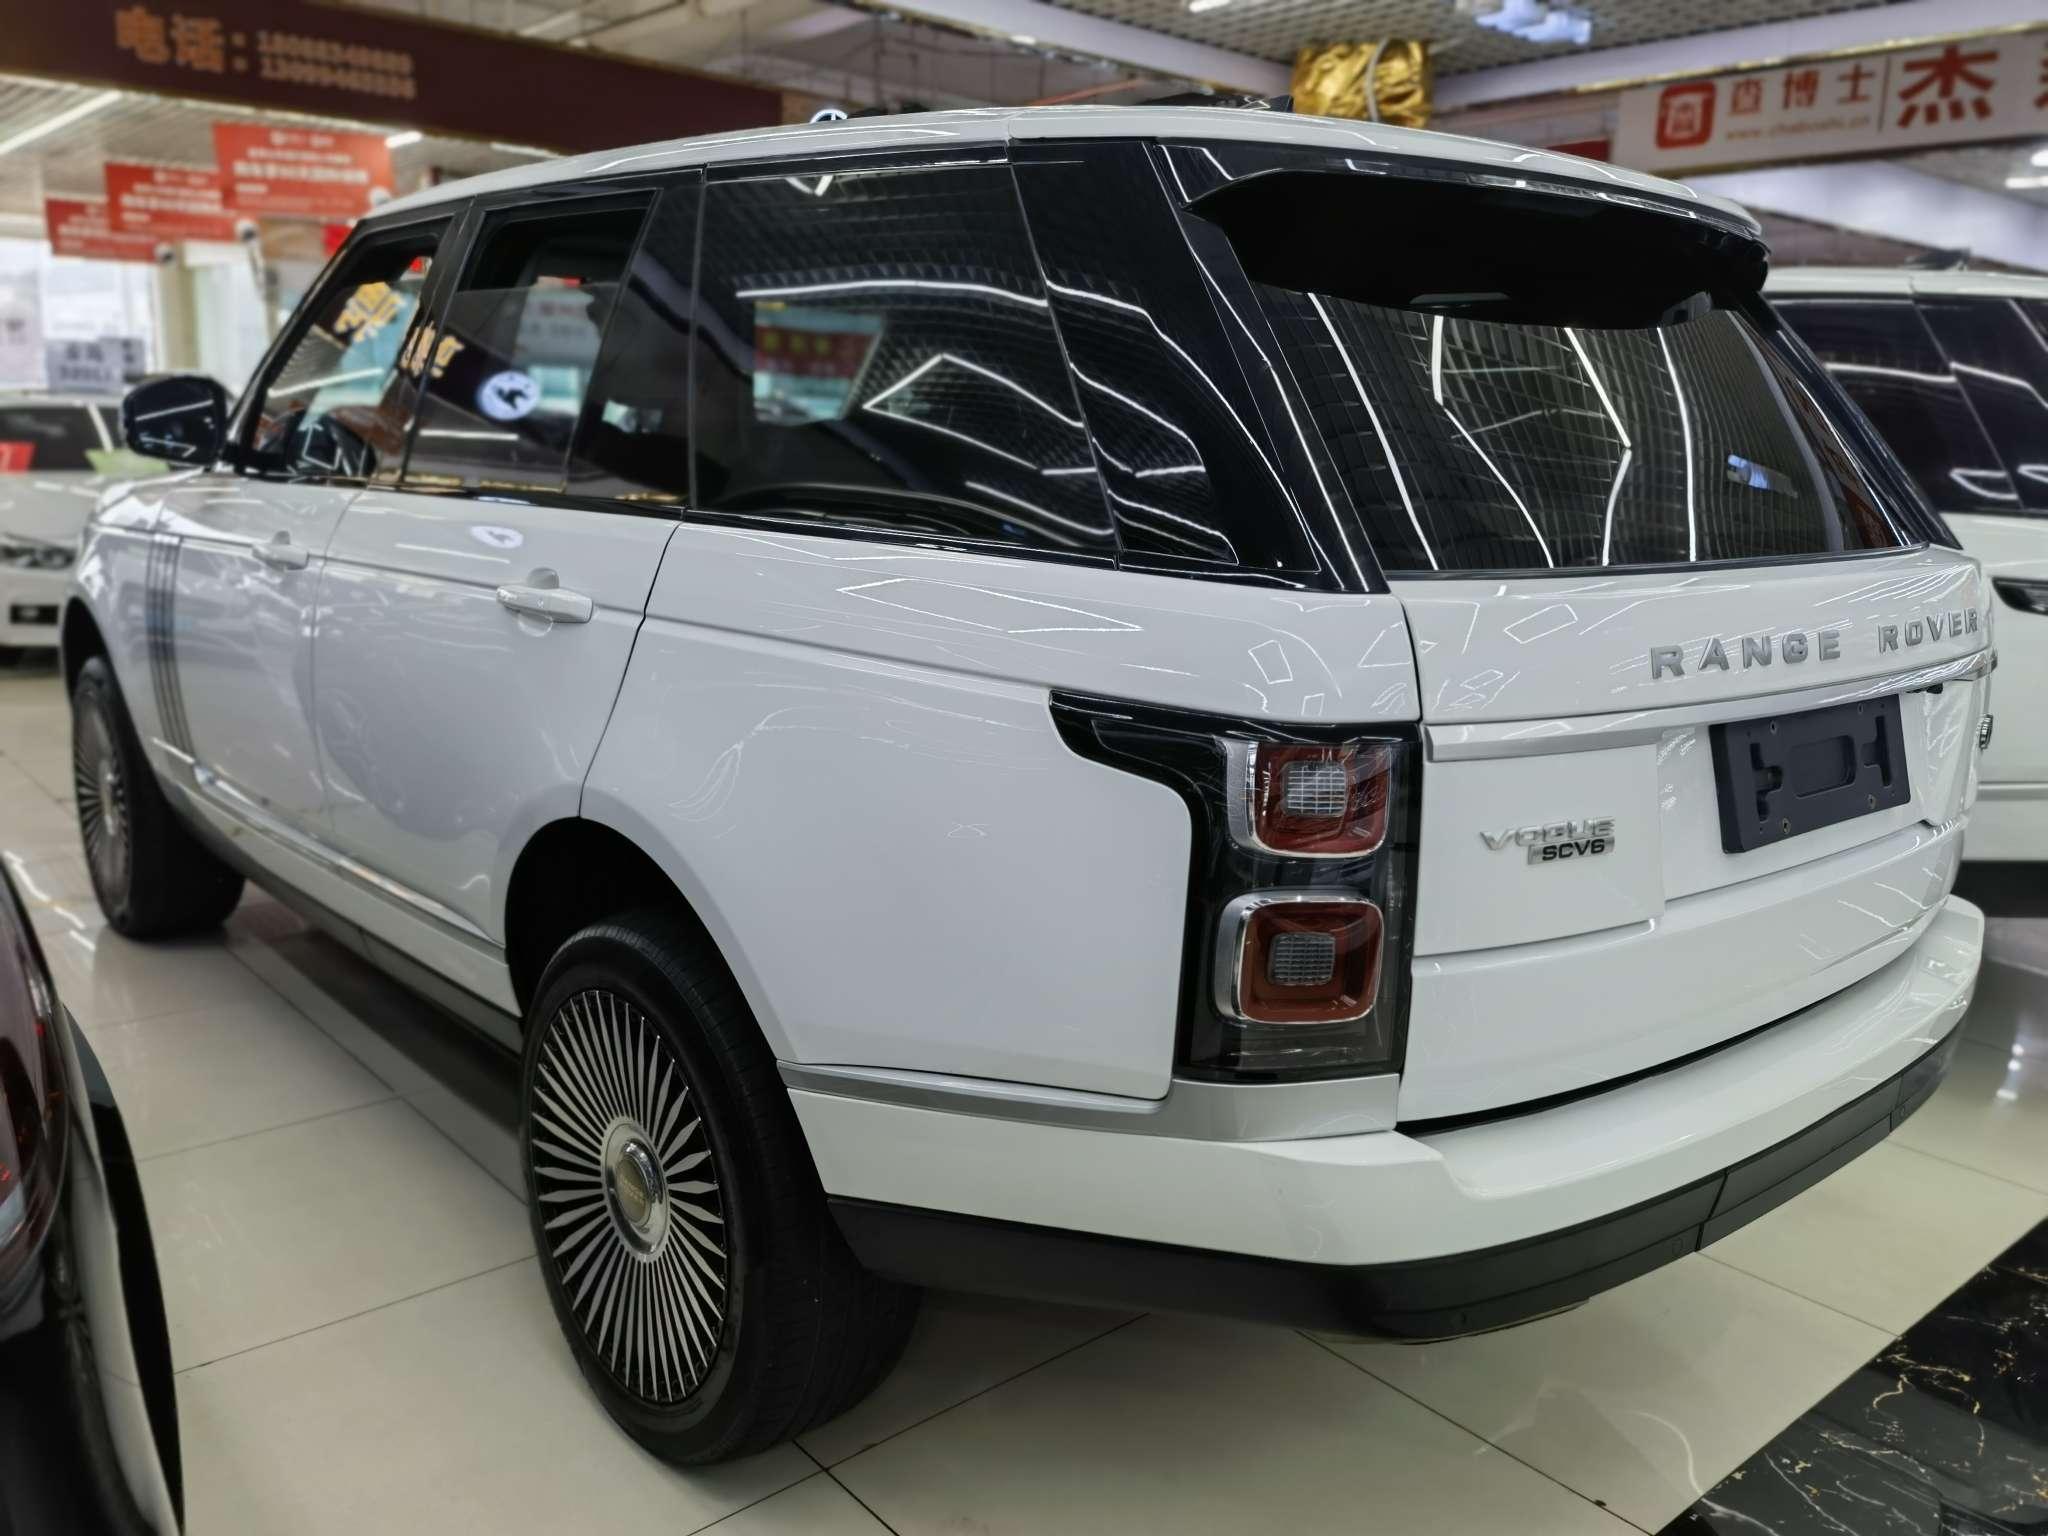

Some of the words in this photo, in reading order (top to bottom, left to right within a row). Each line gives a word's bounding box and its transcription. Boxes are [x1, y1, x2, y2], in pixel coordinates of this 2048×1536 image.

[1898, 43, 2048, 129] 杰
[1650, 629, 1841, 680] RANGE
[1877, 606, 1979, 654] ROVER
[1479, 815, 1616, 851] VOGUE
[1541, 837, 1606, 862] SCV6
